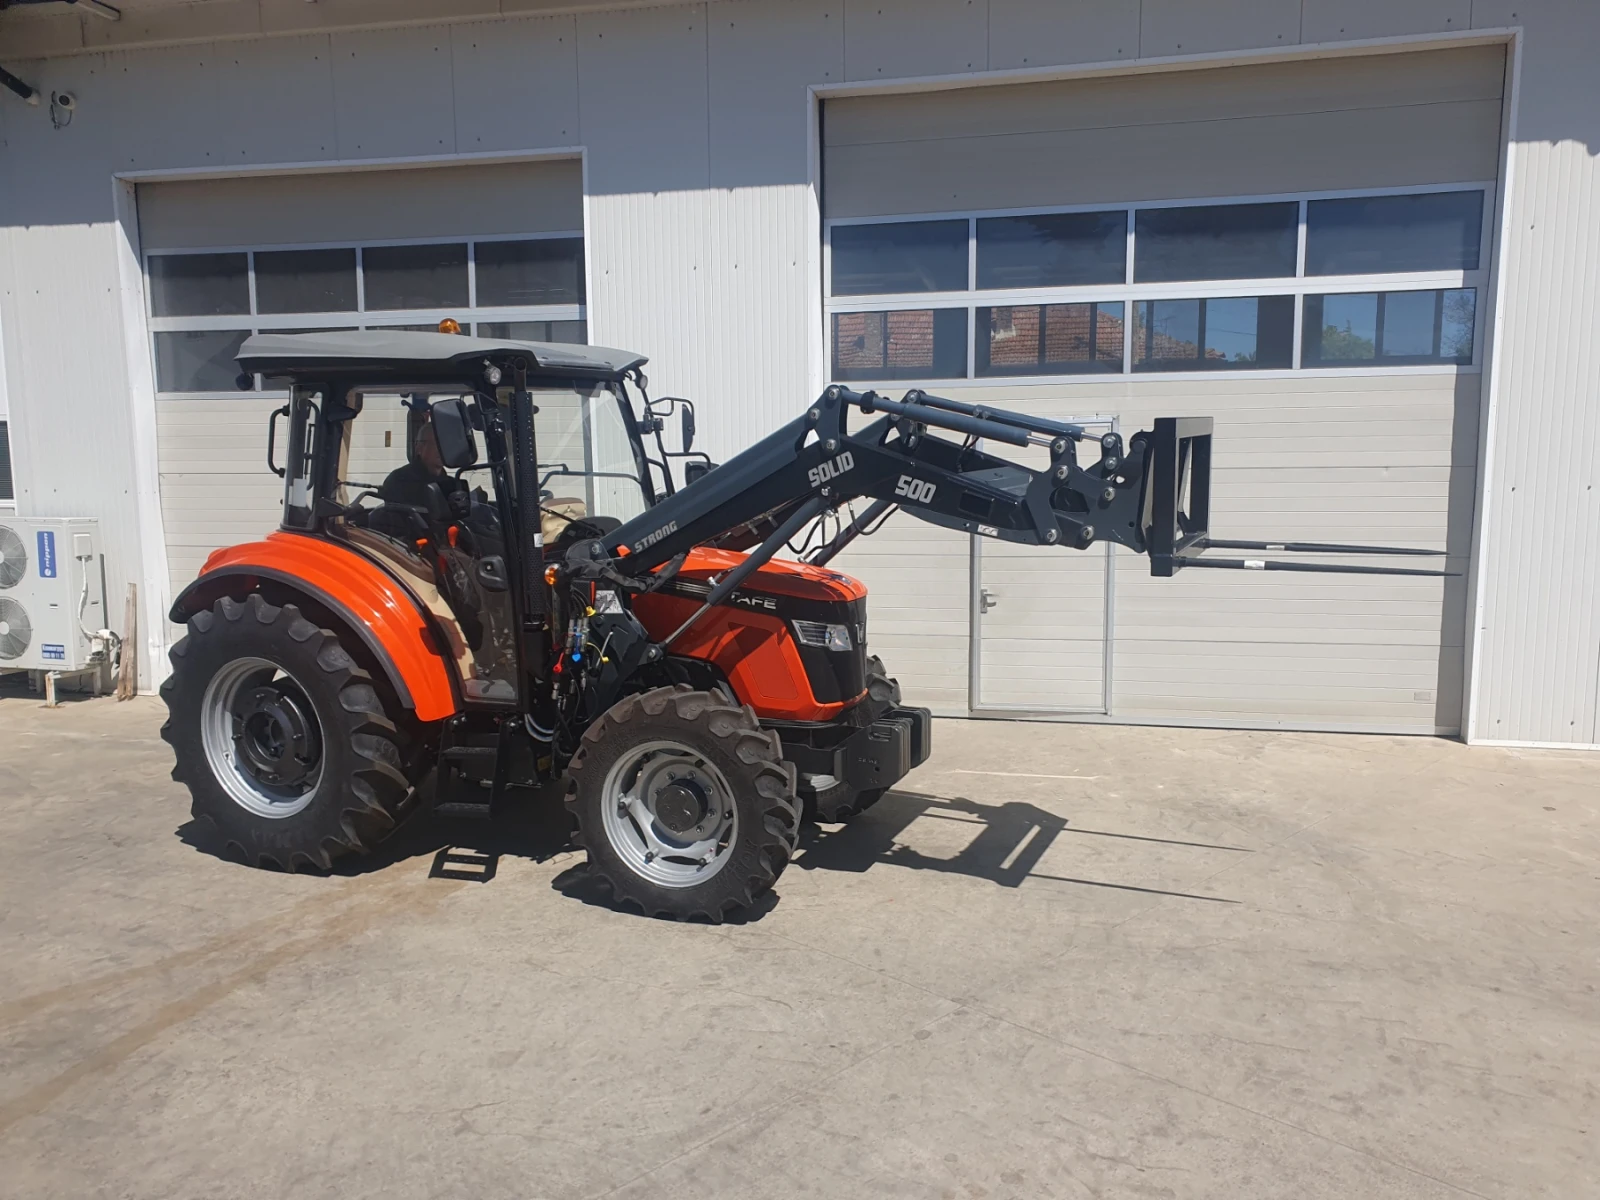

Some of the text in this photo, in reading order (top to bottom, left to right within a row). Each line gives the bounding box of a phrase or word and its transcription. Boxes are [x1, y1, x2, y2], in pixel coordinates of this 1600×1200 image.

[808, 451, 855, 488] SOLID
[894, 474, 937, 504] 500
[634, 520, 678, 553] STRONG
